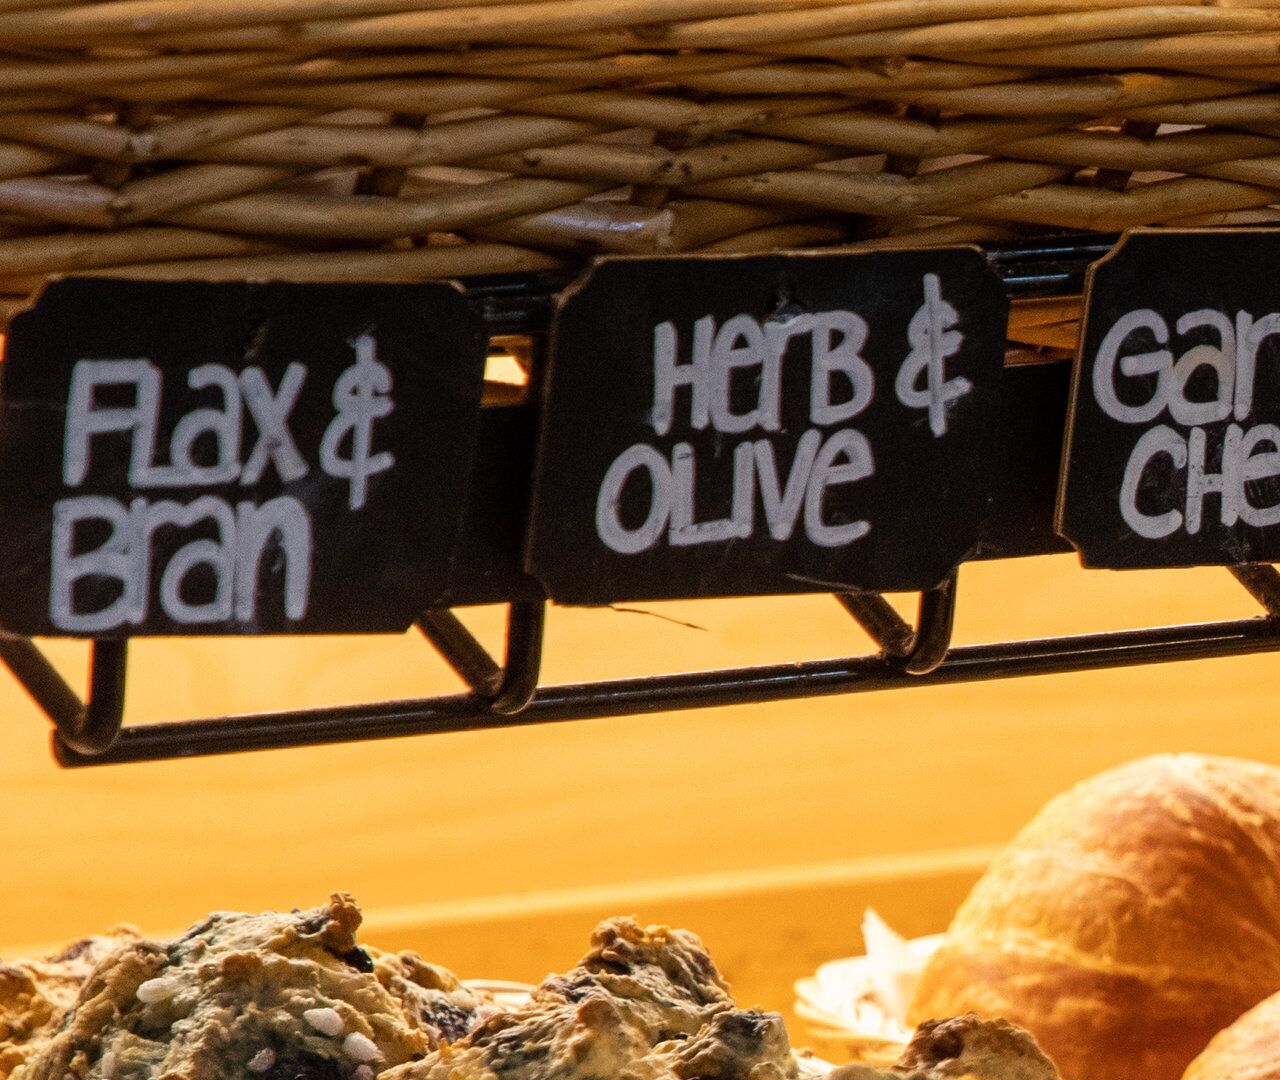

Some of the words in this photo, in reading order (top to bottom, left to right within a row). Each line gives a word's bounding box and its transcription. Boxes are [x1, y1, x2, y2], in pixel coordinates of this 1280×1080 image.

[320, 334, 395, 511] &
[896, 273, 972, 437] &
[49, 495, 311, 630] Bran
